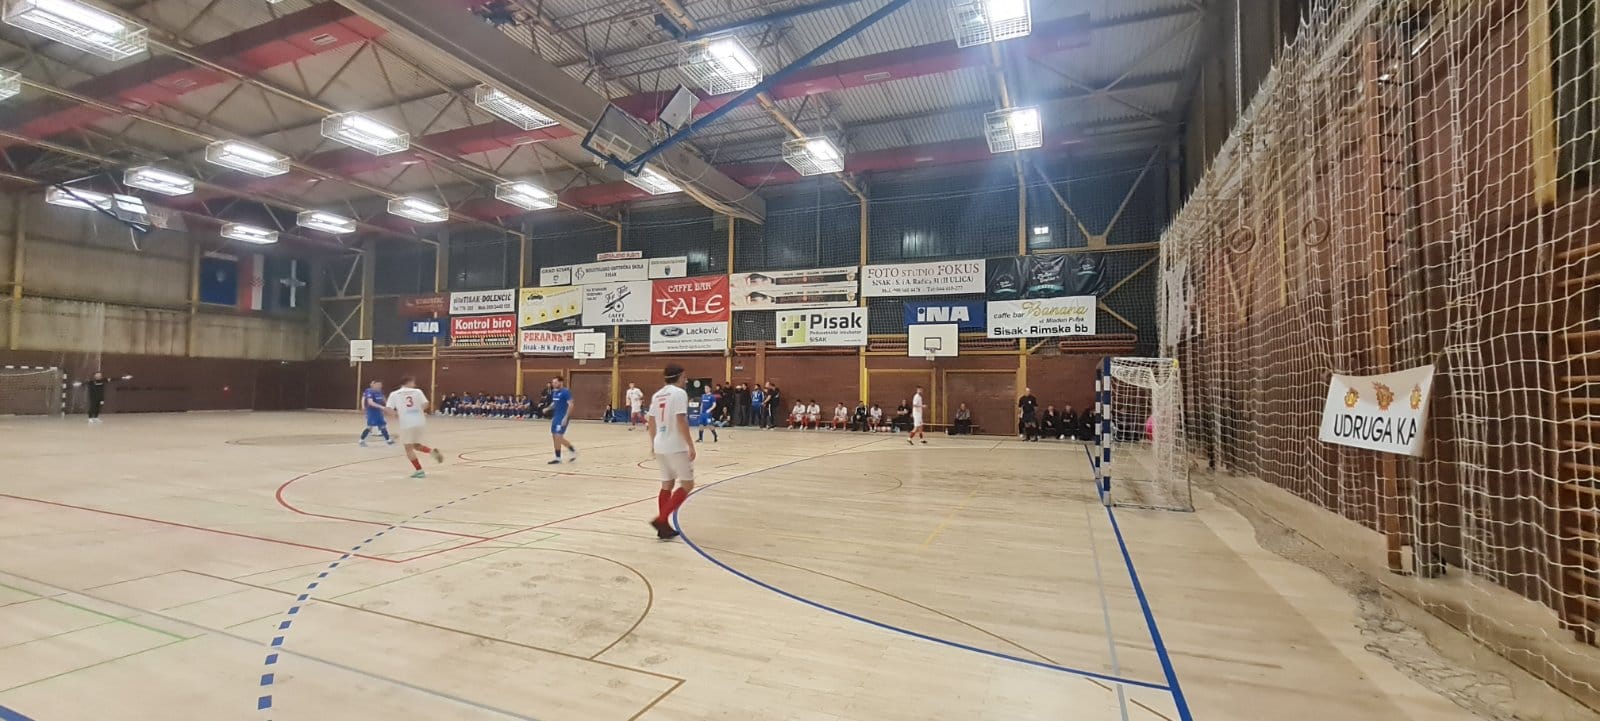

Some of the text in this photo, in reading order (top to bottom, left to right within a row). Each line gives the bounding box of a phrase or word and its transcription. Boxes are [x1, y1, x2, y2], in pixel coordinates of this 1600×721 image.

[868, 263, 980, 278] FOTO STUDIO FOKUS
[668, 282, 712, 293] CAFFE BAR
[655, 294, 725, 318] TALE
[455, 318, 512, 330] Kontrol biro
[810, 312, 862, 329] Pisak
[1030, 325, 1071, 334] Rimska
[1074, 323, 1088, 333] bb
[405, 396, 414, 408] 3
[659, 402, 667, 422] 7
[1333, 413, 1393, 444] UDRUGA
